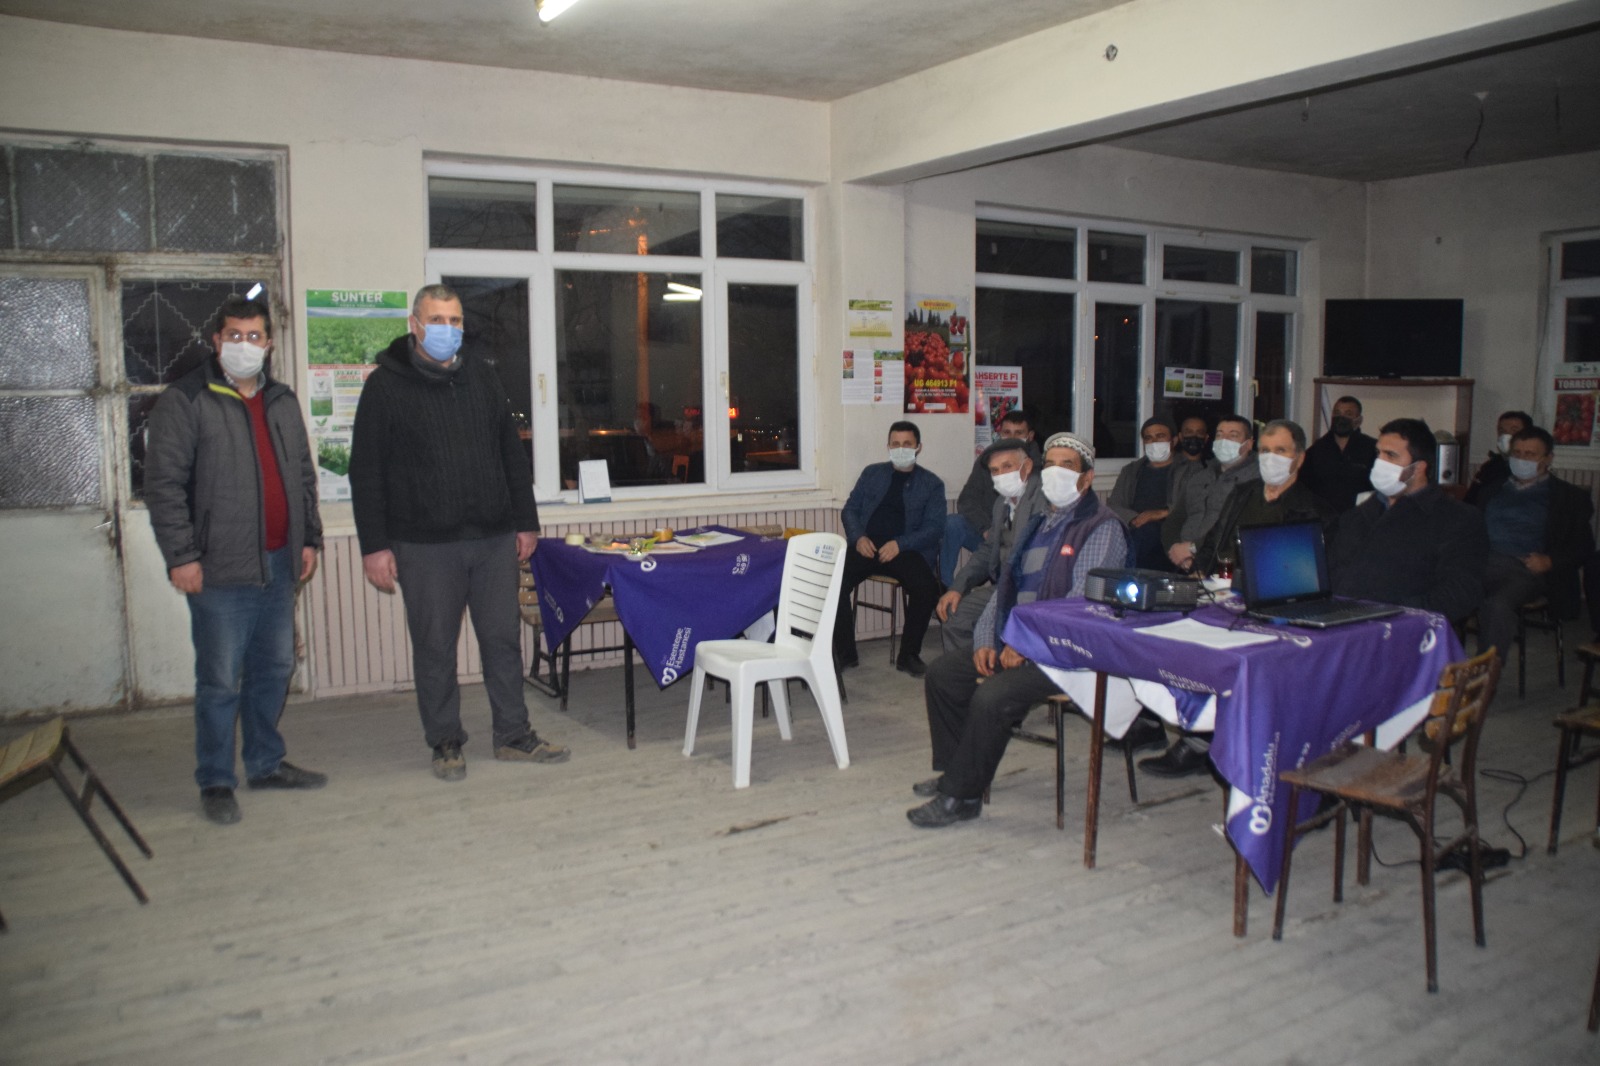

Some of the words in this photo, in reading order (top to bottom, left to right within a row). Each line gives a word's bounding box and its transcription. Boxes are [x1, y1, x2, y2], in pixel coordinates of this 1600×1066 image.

[332, 291, 383, 303] SUNTER
[926, 379, 948, 387] 464913
[666, 628, 683, 667] Esentepe
[674, 626, 691, 668] Hastanesi
[1256, 743, 1275, 806] Anadolu
